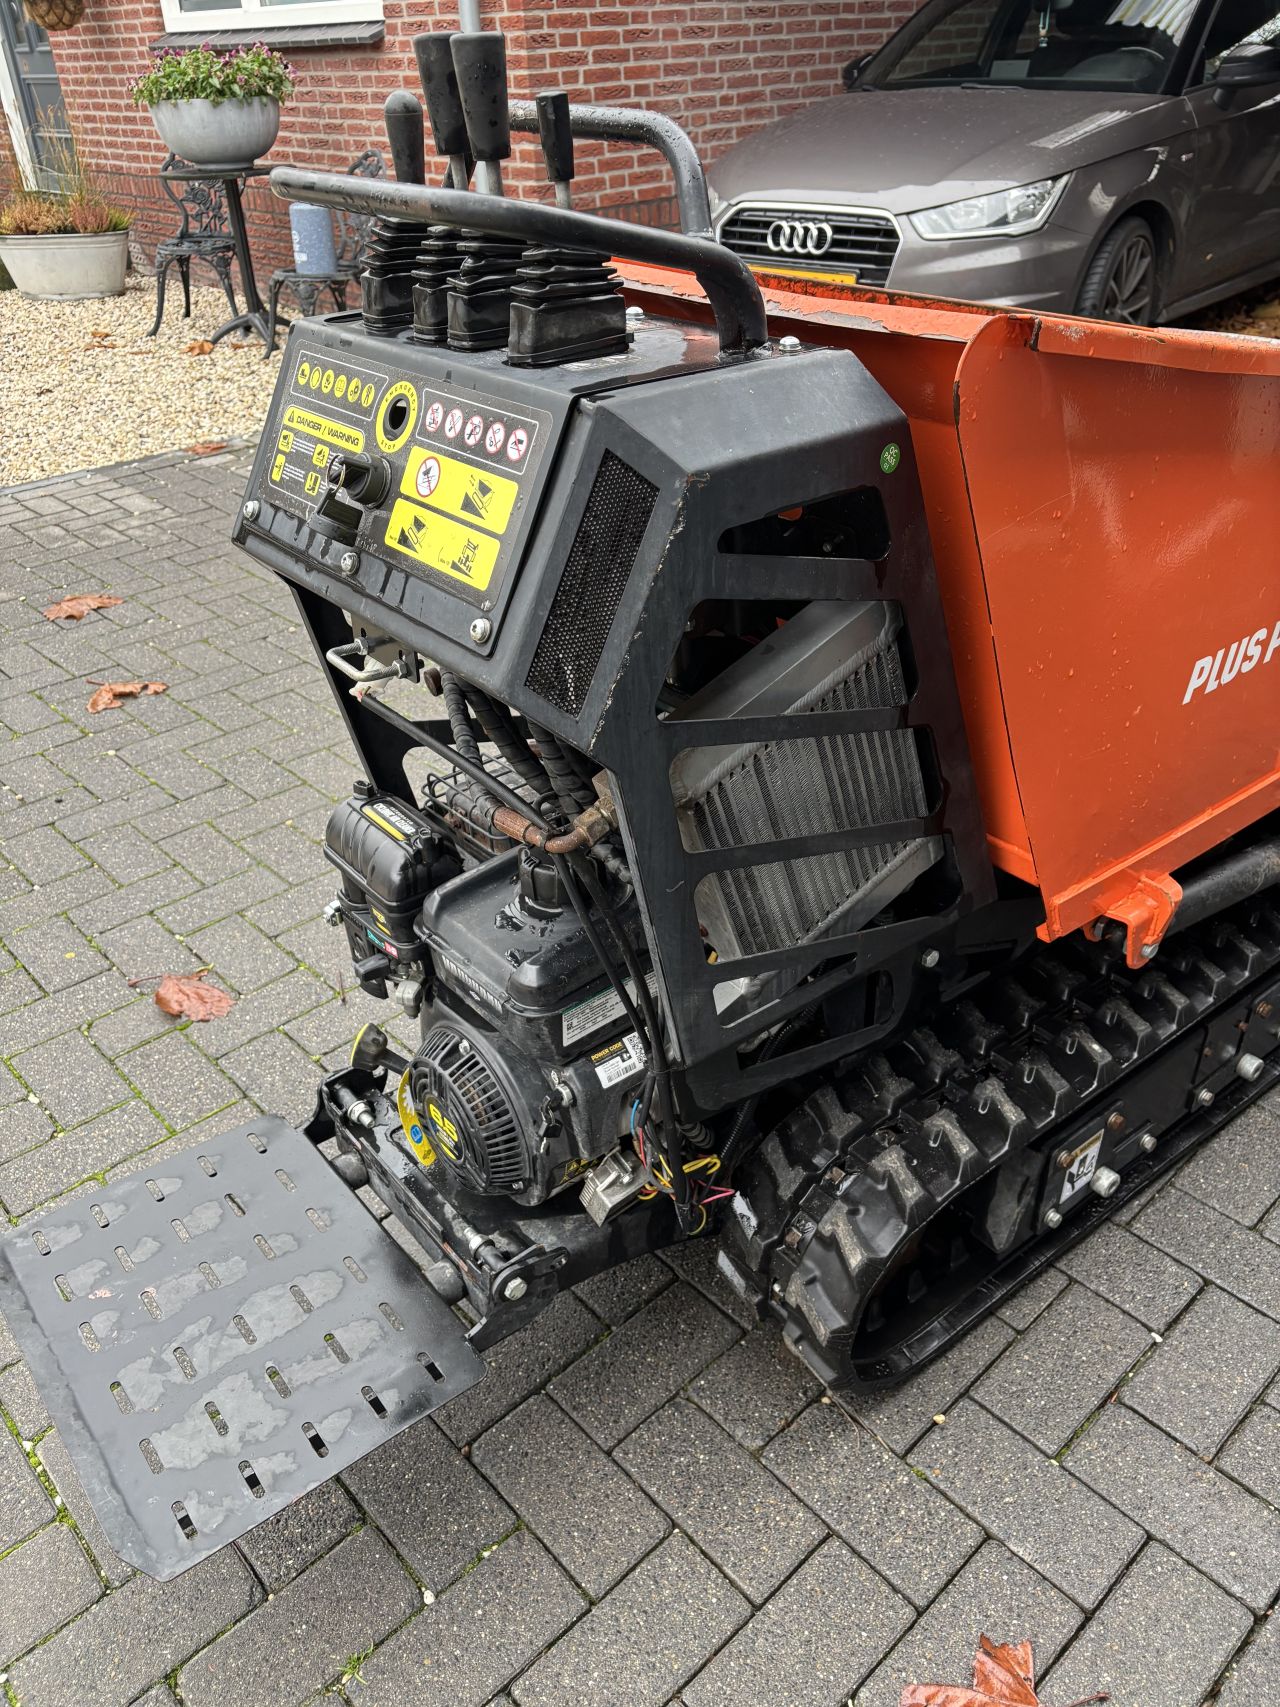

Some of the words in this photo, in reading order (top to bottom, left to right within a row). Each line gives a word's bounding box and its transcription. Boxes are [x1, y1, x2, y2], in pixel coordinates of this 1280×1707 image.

[296, 415, 322, 432] DANGER
[327, 426, 360, 447] WARNING
[380, 439, 396, 450] STOP
[1182, 627, 1268, 706] PLUS
[590, 1048, 610, 1062] POWER
